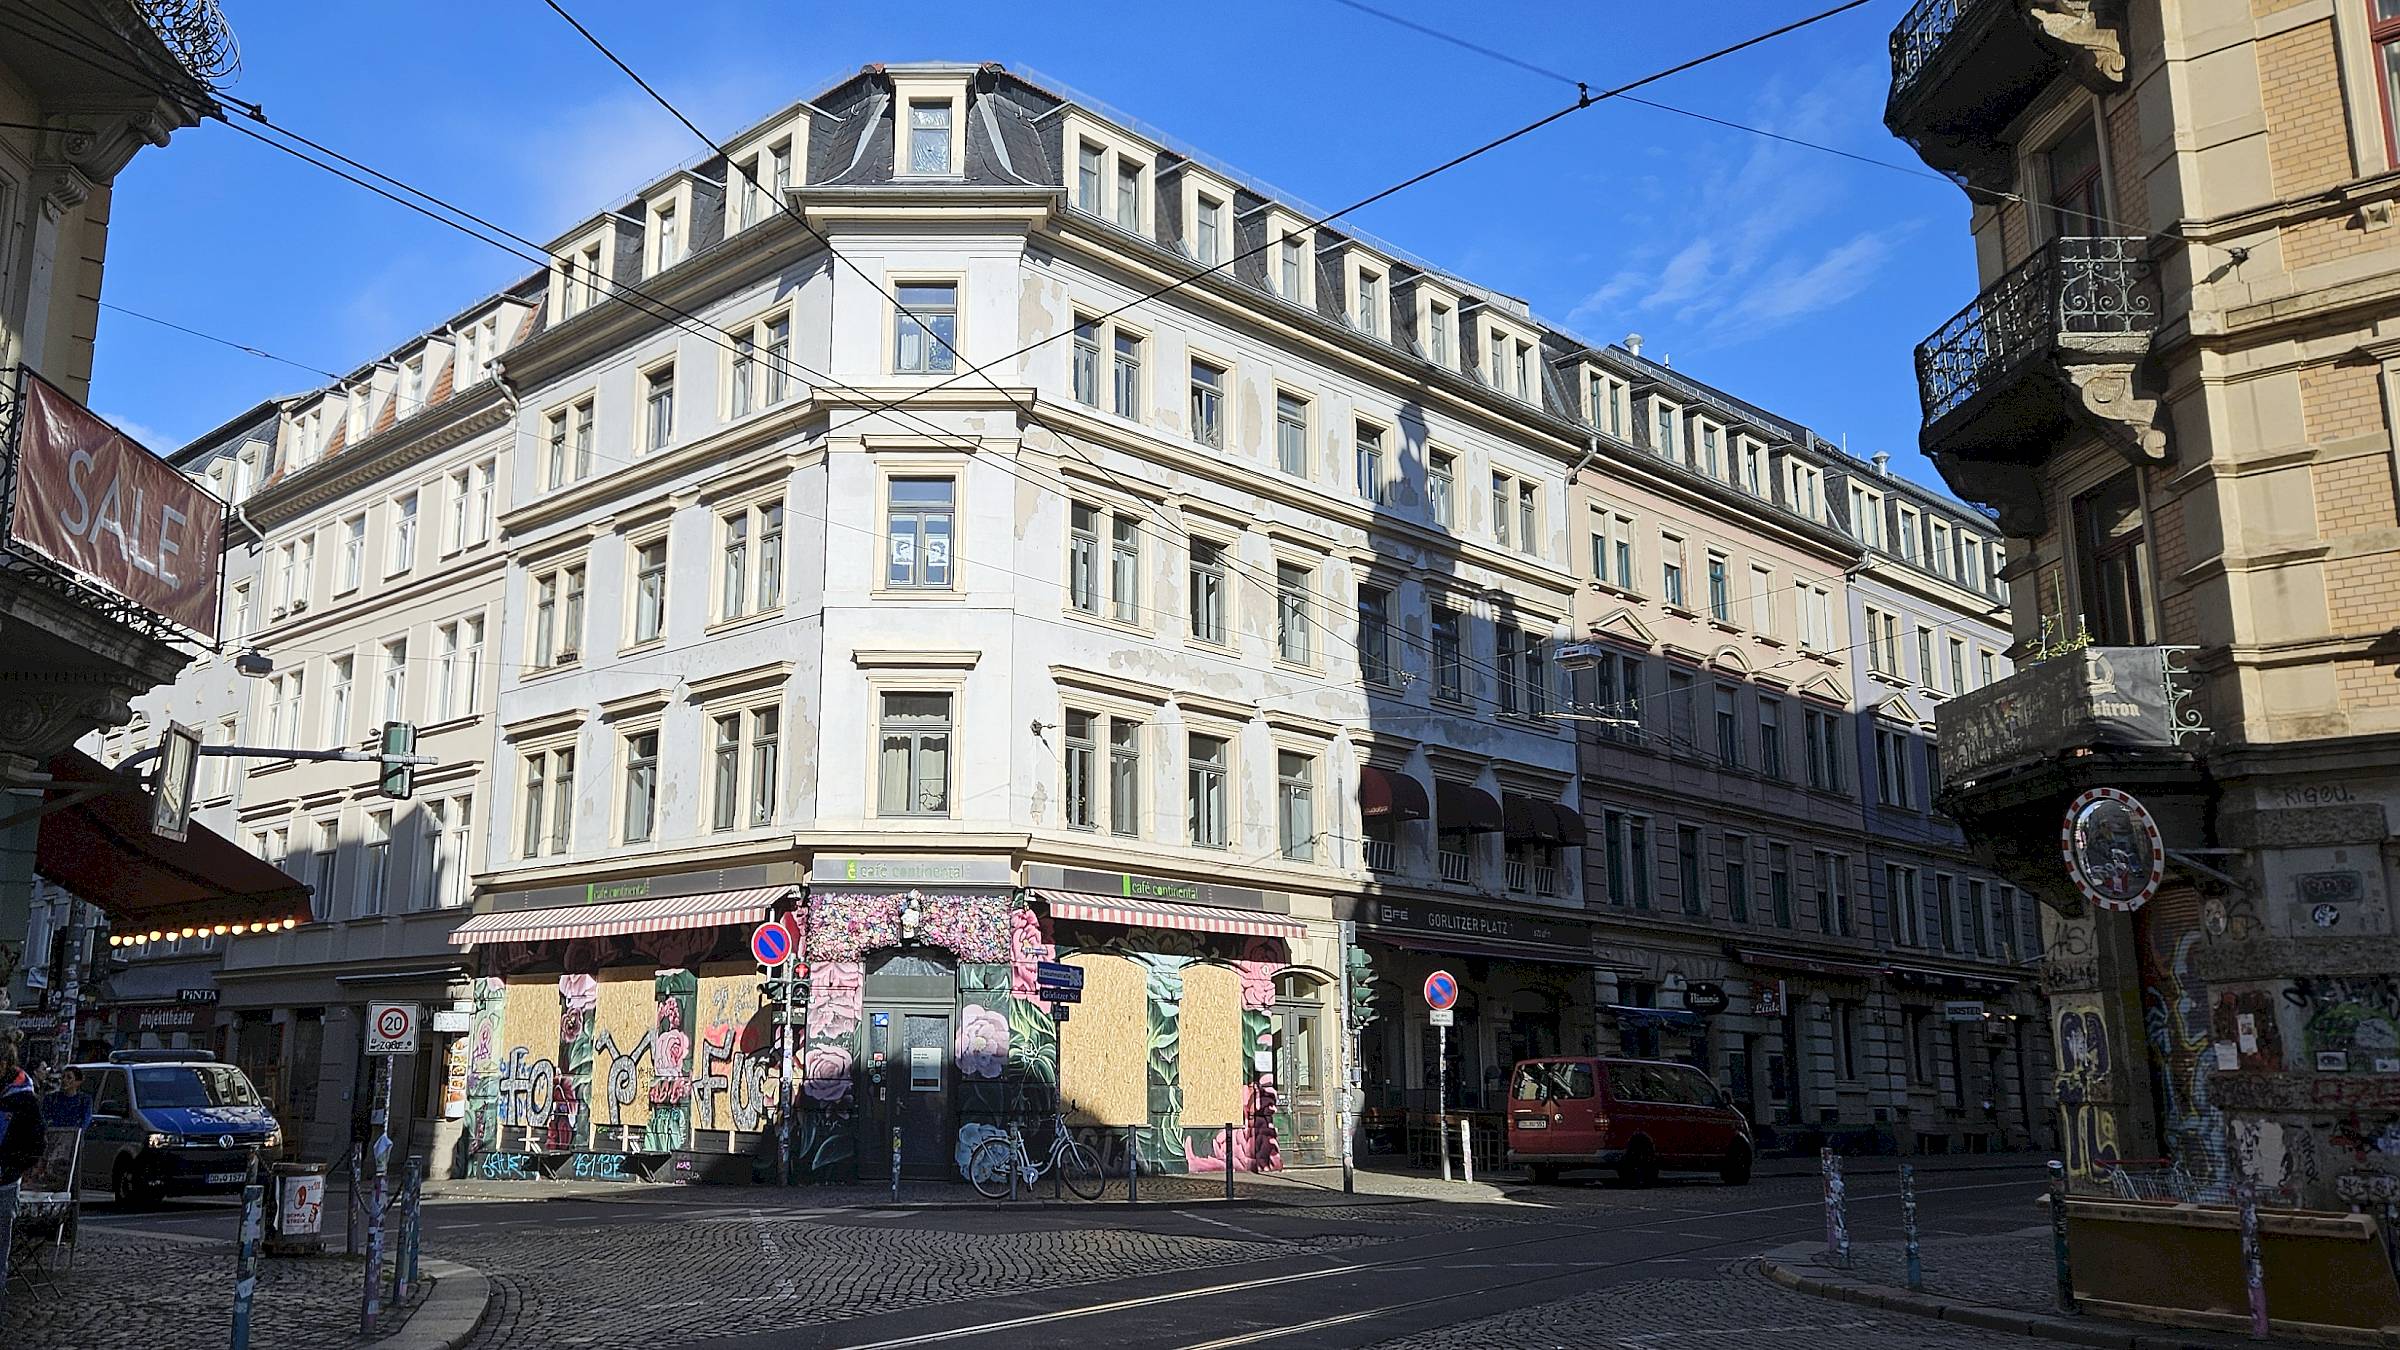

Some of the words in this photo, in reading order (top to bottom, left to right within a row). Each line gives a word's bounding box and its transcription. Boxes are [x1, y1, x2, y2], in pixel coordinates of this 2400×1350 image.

[60, 449, 187, 590] SALE
[1131, 881, 1150, 895] café
[1152, 884, 1199, 900] continental
[1480, 919, 1508, 935] PLATZ
[139, 1010, 195, 1030] projekttheater
[384, 1016, 402, 1031] 20
